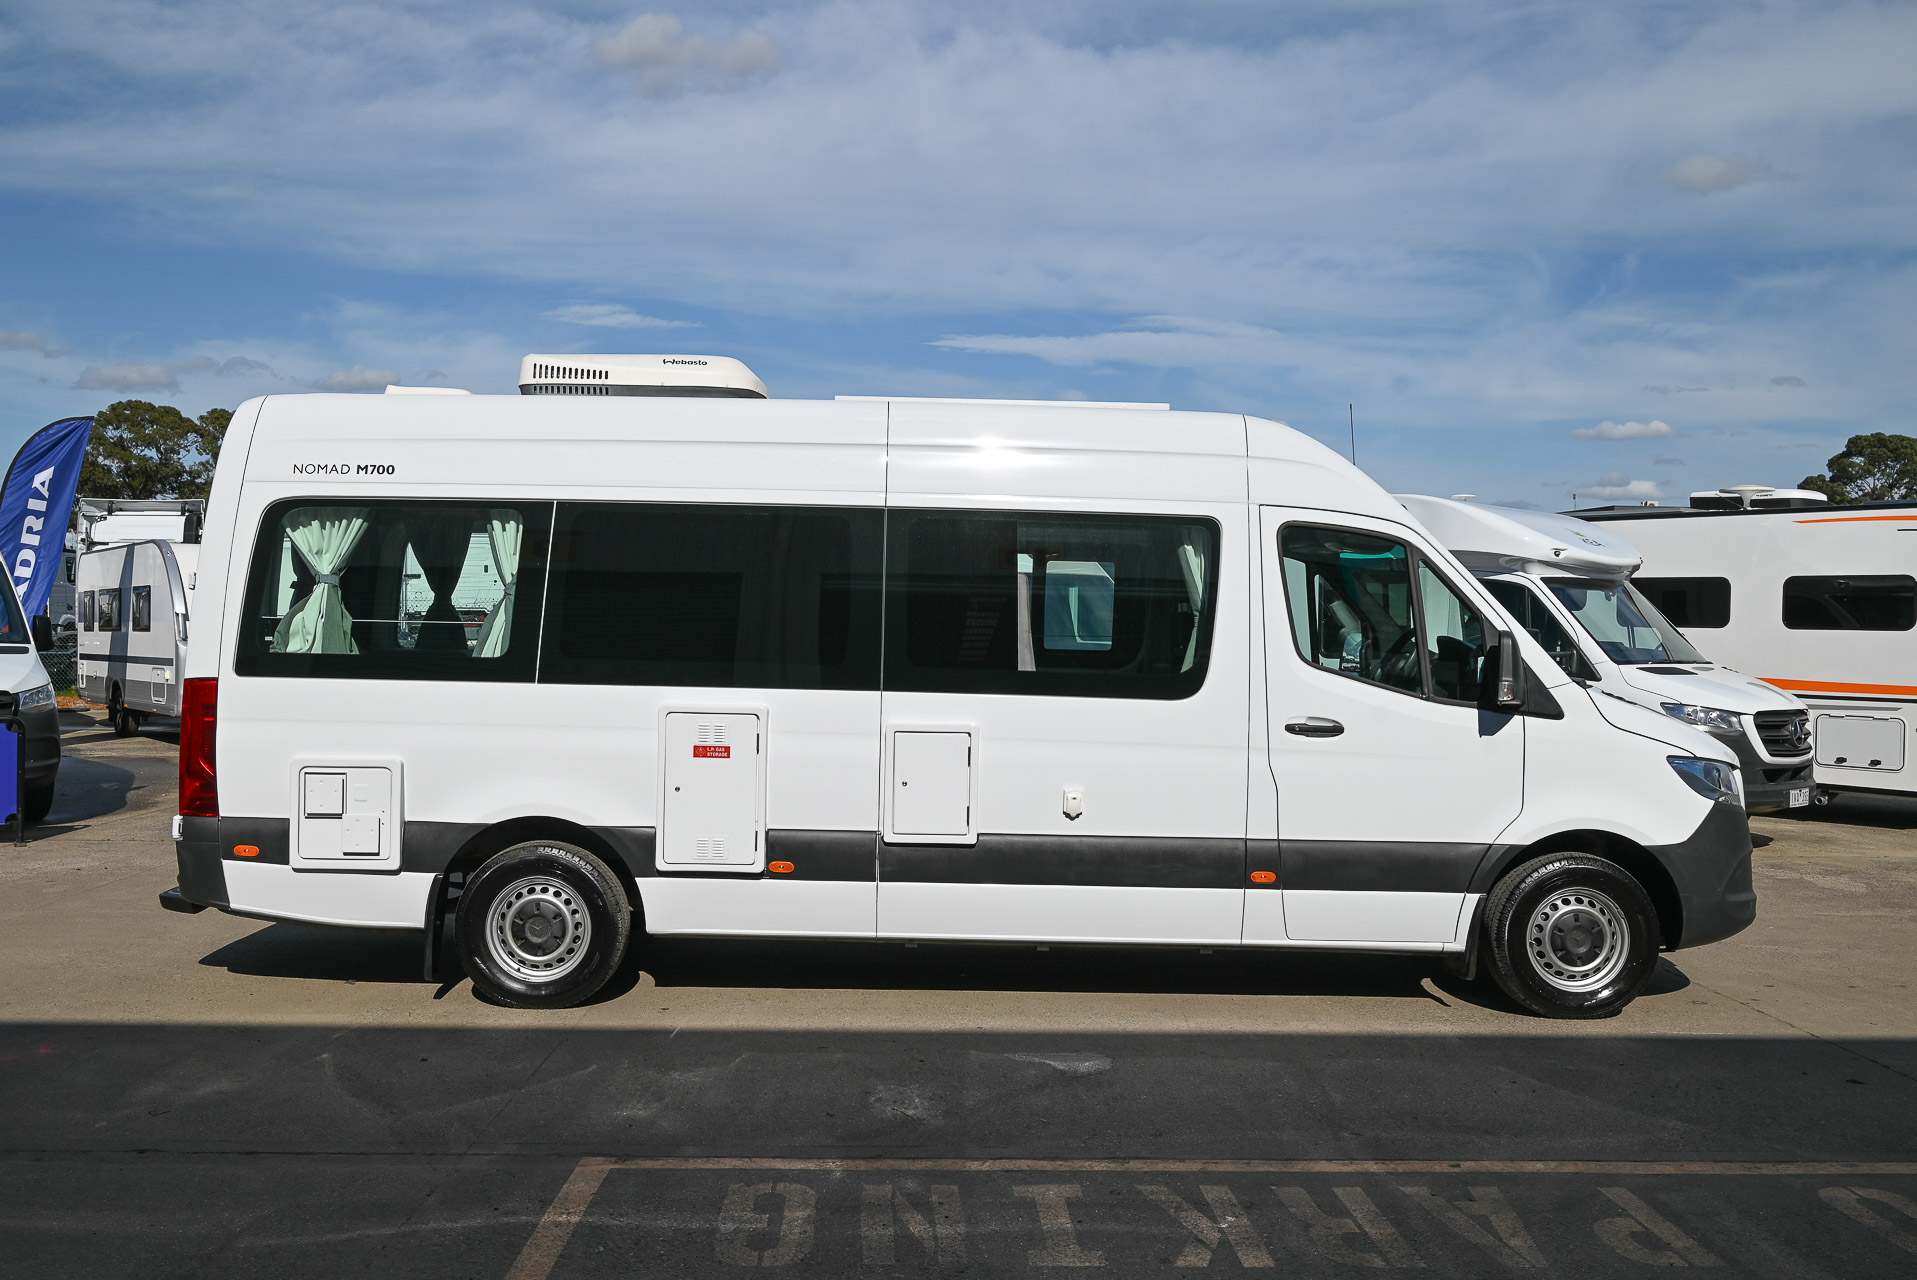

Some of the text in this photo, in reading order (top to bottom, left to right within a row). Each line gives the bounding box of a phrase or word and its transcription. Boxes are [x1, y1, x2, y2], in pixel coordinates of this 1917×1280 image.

[662, 358, 708, 366] Webasto
[293, 463, 396, 475] NOMAD M700
[713, 1182, 1724, 1268] PARKING
